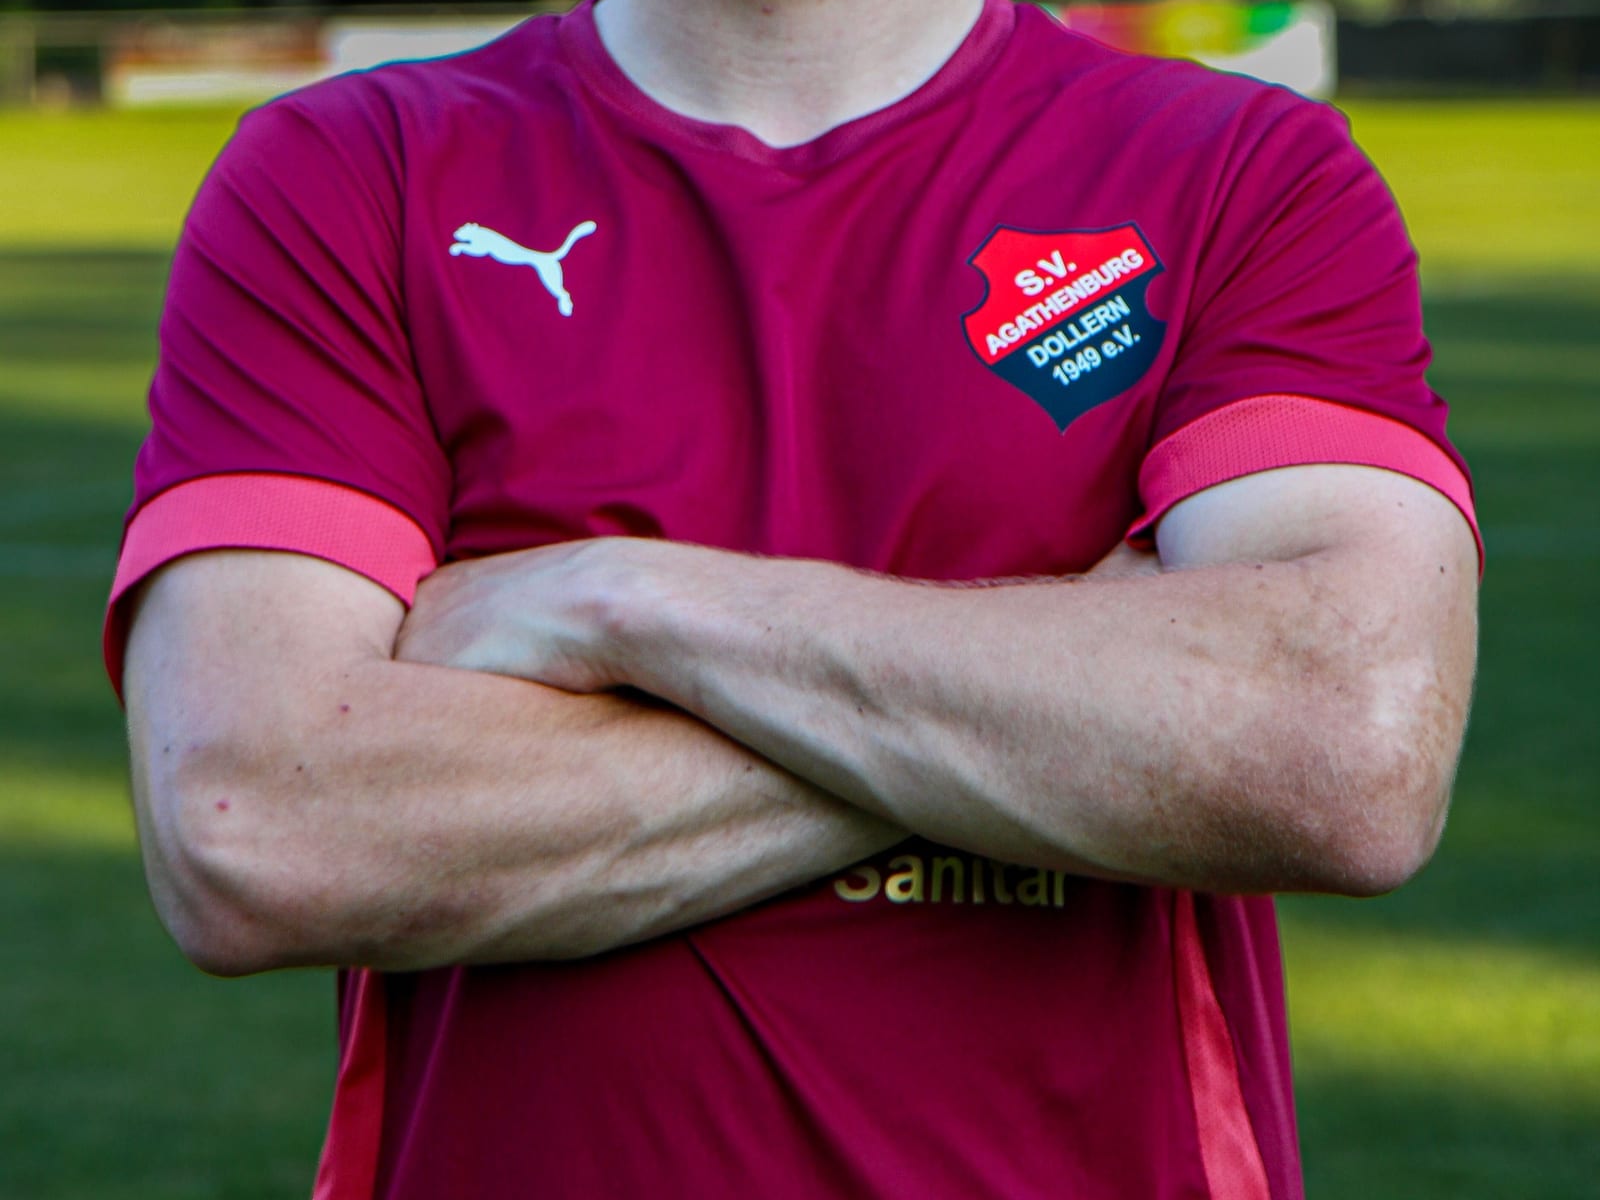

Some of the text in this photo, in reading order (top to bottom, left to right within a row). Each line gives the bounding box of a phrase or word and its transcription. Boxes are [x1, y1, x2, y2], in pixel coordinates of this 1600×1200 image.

[985, 248, 1144, 356] AGATHENBURG
[1014, 249, 1077, 297] S.V.
[1026, 295, 1131, 368] DOLLERN
[1053, 324, 1141, 386] 1949 e.V.
